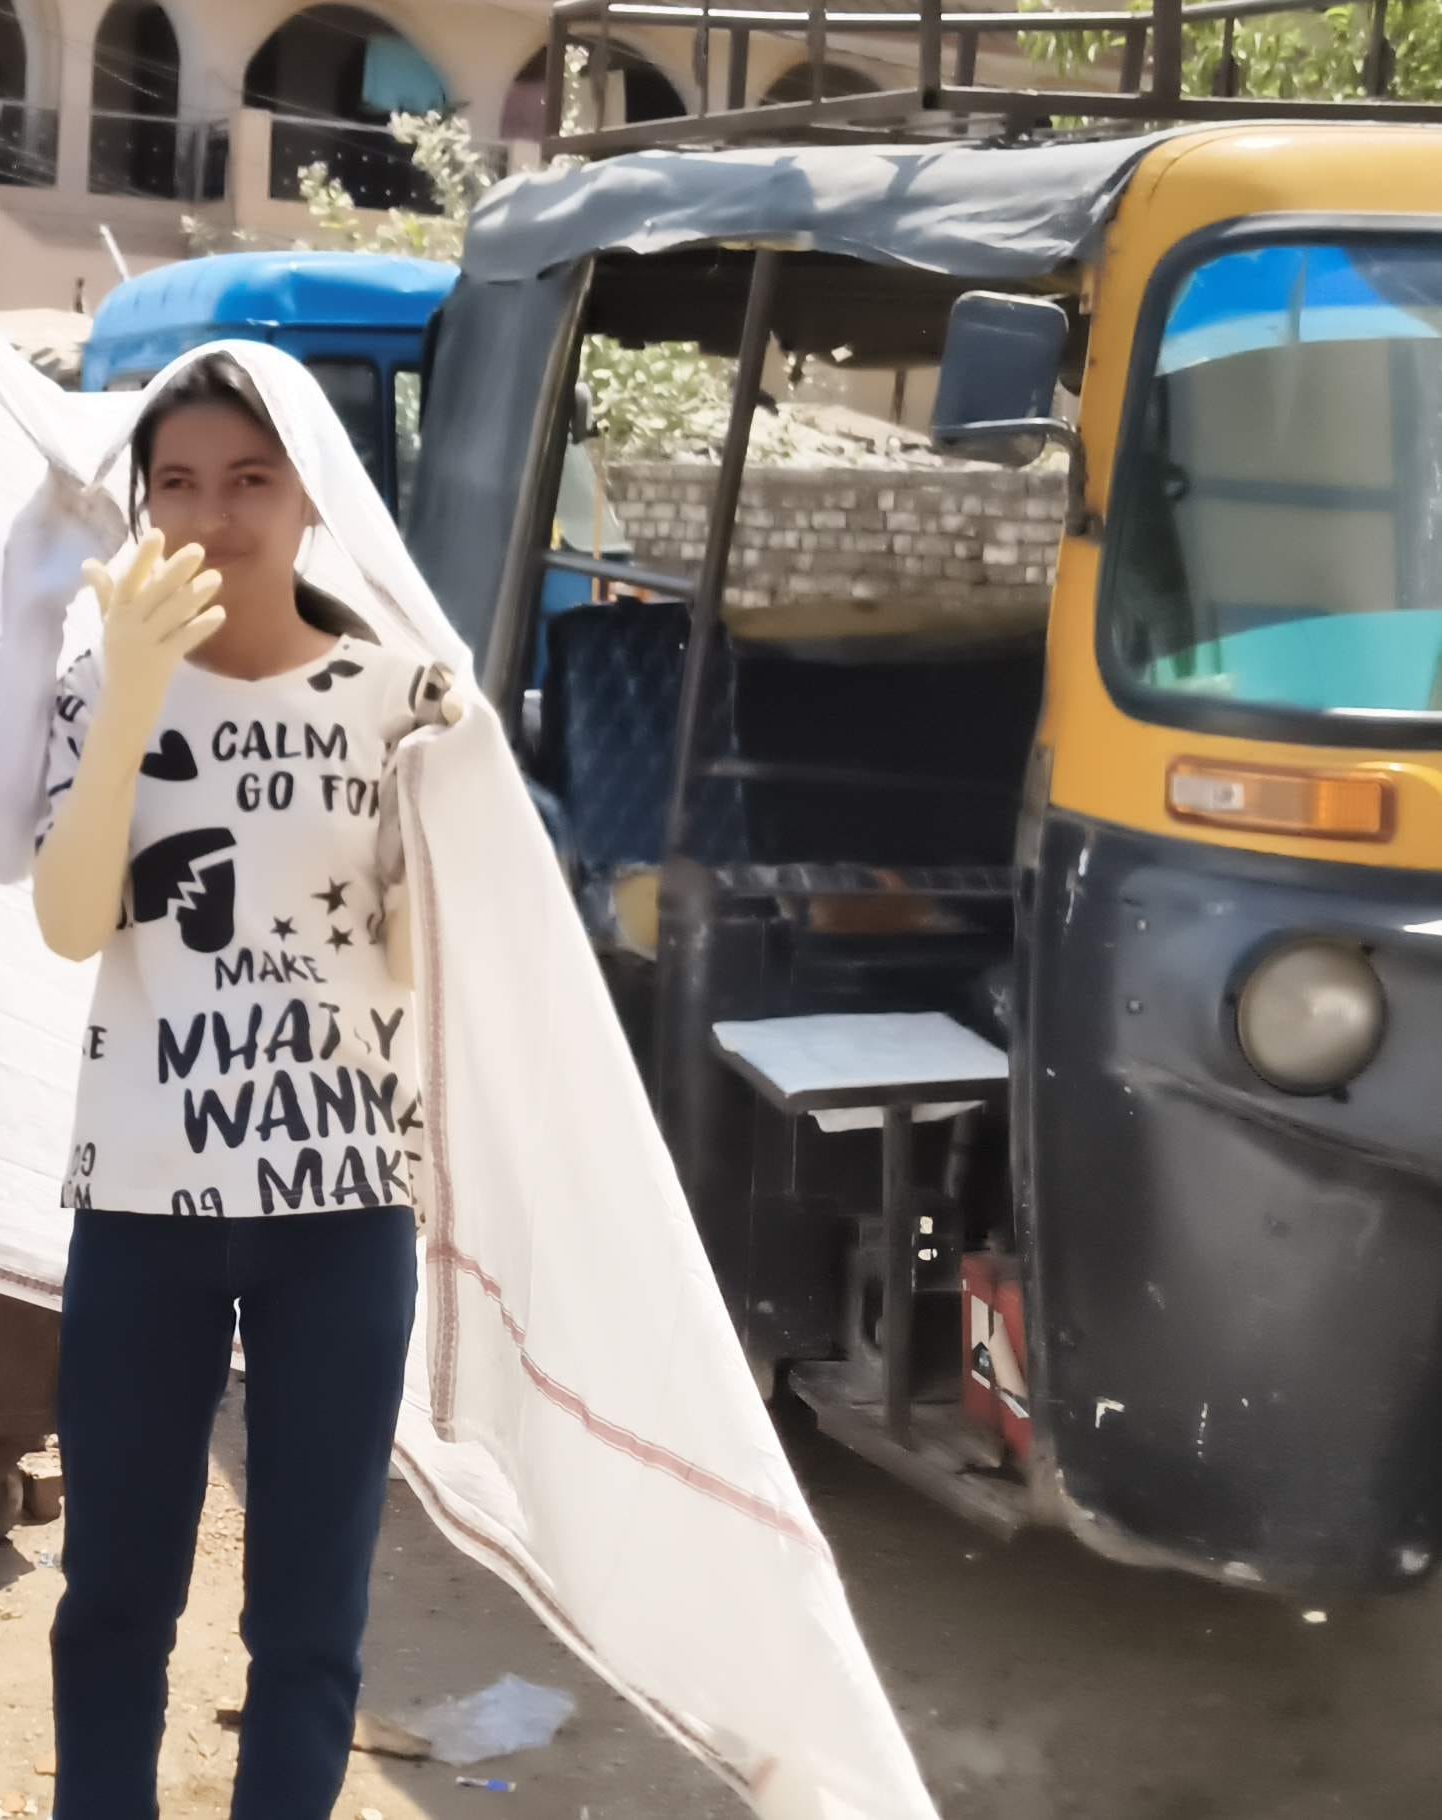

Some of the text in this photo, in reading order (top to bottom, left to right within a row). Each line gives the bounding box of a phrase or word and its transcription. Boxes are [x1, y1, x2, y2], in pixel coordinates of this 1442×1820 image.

[211, 720, 348, 761] CALM
[236, 771, 295, 813] GO
[214, 947, 328, 991] MAKE
